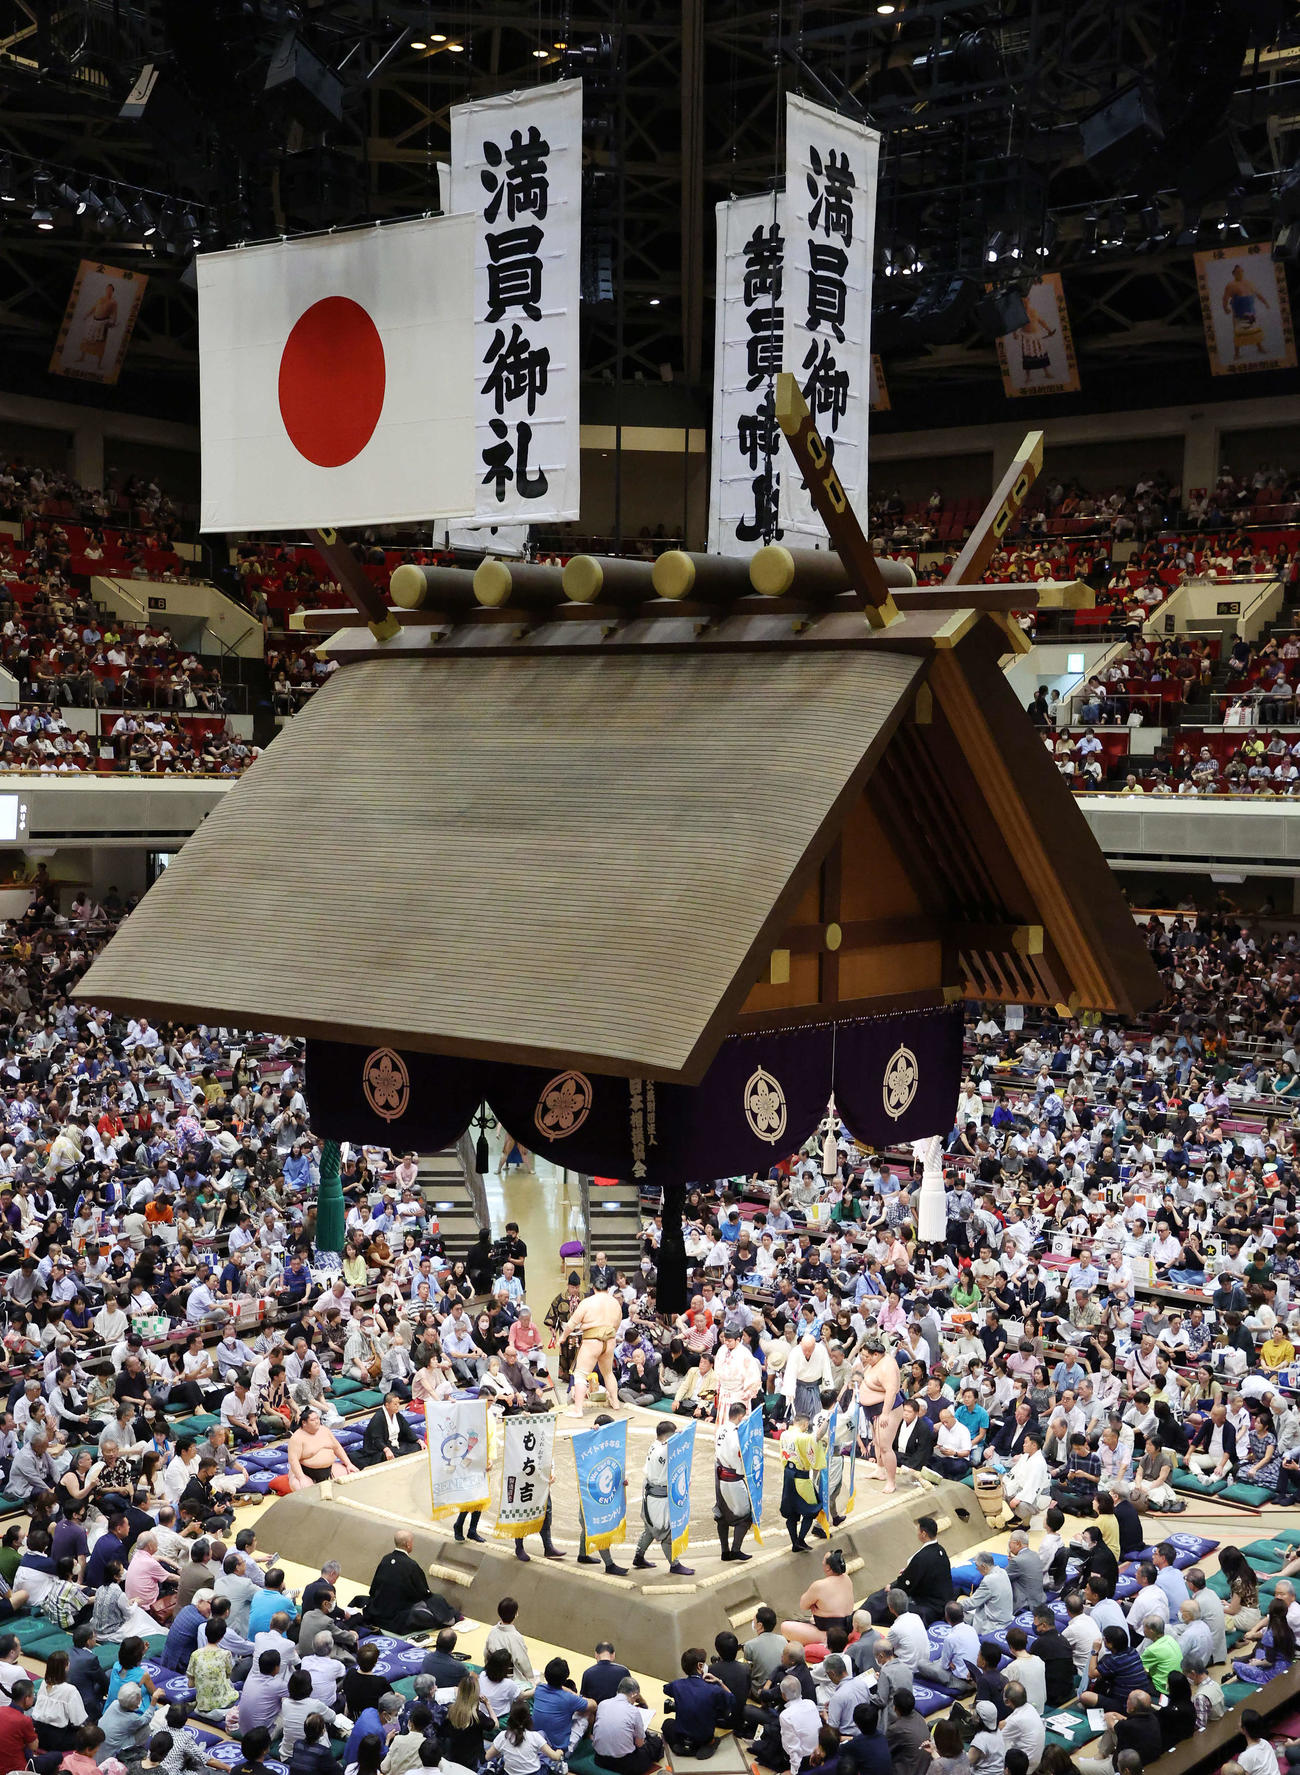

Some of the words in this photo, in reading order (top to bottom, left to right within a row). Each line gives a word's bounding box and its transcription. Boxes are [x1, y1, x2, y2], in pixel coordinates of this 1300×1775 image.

[481, 125, 550, 503] 満員御礼
[629, 1079, 648, 1178] 日本相撲協会
[519, 1430, 537, 1503] もち吉
